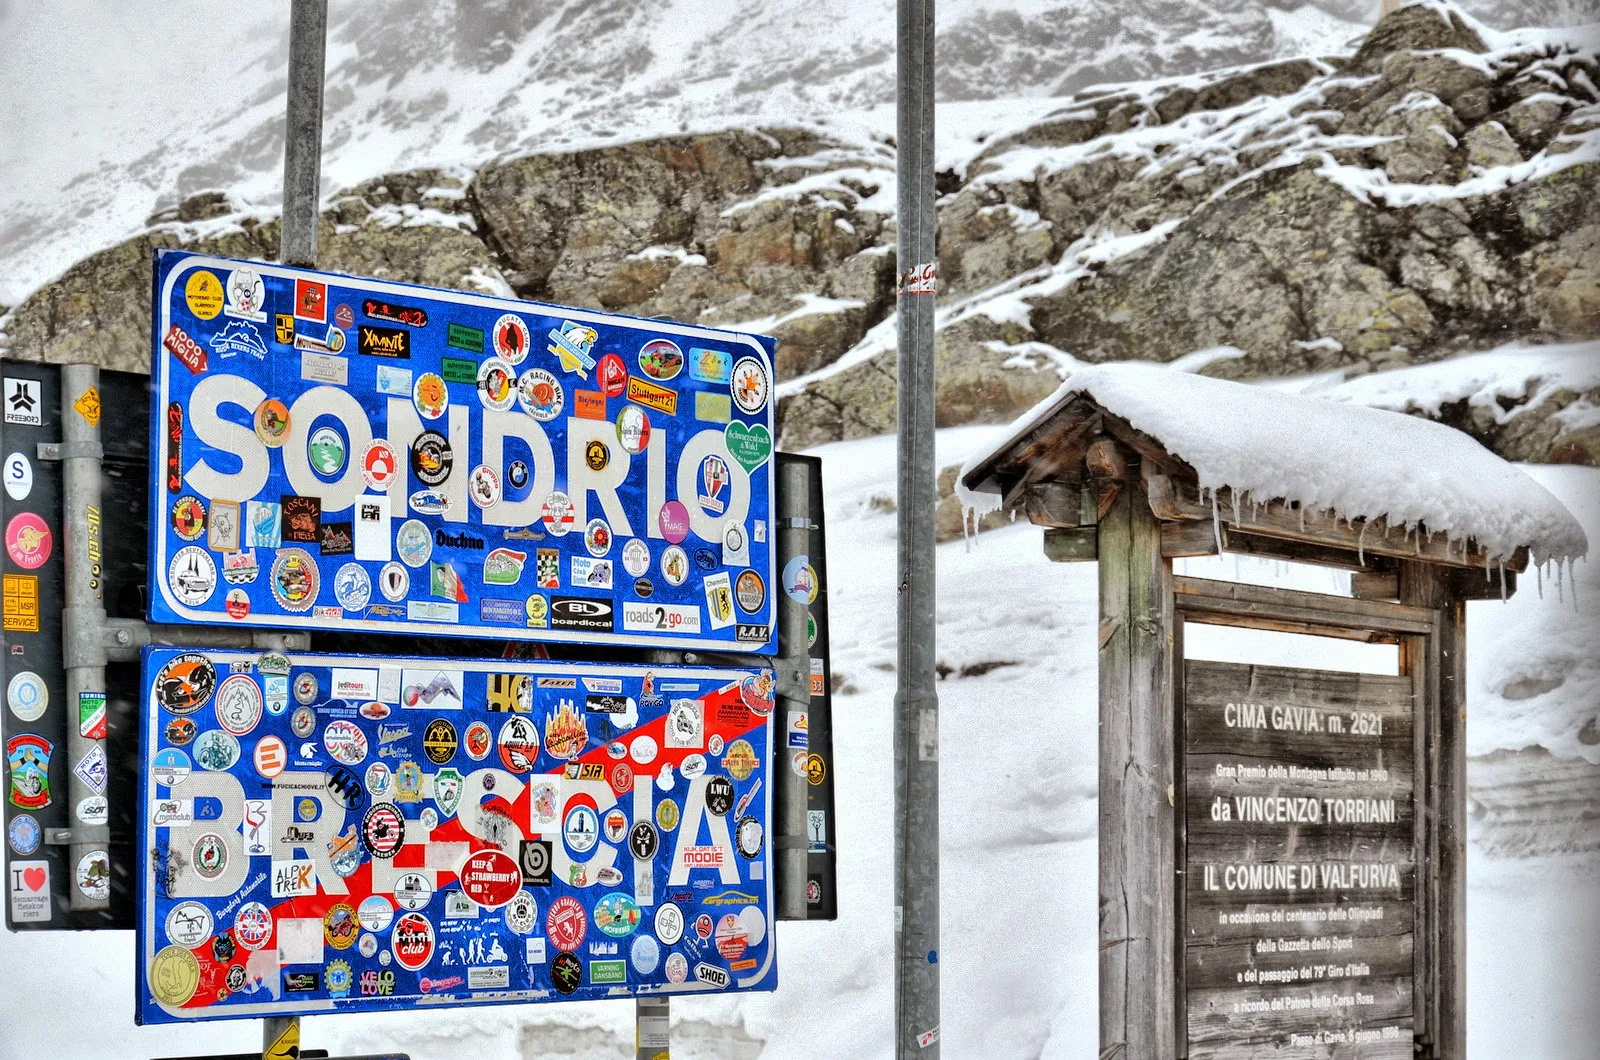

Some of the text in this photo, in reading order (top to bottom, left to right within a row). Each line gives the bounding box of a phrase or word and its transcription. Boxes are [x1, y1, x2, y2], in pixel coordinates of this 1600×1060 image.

[174, 327, 203, 355] 1000
[166, 334, 199, 368] MIGLIA
[530, 372, 555, 387] RACING
[631, 384, 674, 407] Stuttgart 21
[7, 413, 39, 423] FREEBORD
[183, 373, 751, 544] SONDRIO
[12, 461, 24, 479] S
[482, 467, 499, 489] Gruppo
[284, 499, 319, 517] TOSCANI
[294, 532, 316, 540] PIEGA
[573, 558, 591, 567] Moto
[706, 577, 728, 587] Chemnitz
[569, 604, 594, 614] BL
[4, 618, 35, 627] SERVICE
[552, 618, 612, 628] boardlocal
[739, 627, 768, 638] R.A.V.
[184, 655, 214, 674] together
[812, 681, 822, 691] 33
[1224, 703, 1383, 736] CIMA GAVIA: m. 2621
[583, 765, 603, 777] SIR
[1216, 764, 1235, 777] Gran
[1238, 764, 1266, 778] Premio
[1268, 765, 1287, 778] della
[1290, 766, 1327, 781] Montagna
[1357, 770, 1369, 780] nel
[711, 784, 729, 796] LWU
[1211, 797, 1395, 823] da VINCENZO TORRIANI
[168, 770, 741, 898] BRESCIA
[373, 849, 396, 857] BREMEN
[684, 853, 723, 862] MOOIE
[472, 860, 485, 869] KEEP
[277, 865, 299, 880] ALP
[471, 872, 510, 882] STRAWBERRY
[1204, 864, 1399, 891] IL COMUNE DI VALFURVA
[13, 870, 23, 891] I
[471, 884, 482, 893] RED
[514, 898, 530, 906] ASKER
[1219, 907, 1384, 923] in occasione del centenario delle Olimpiadi
[399, 936, 428, 947] MINI
[401, 942, 425, 954] club
[1256, 936, 1353, 953] della Gazzetta dello Sport
[566, 958, 580, 972] moto
[361, 971, 394, 981] VELO
[700, 967, 726, 985] SHOEI
[1237, 974, 1243, 982] e
[1244, 969, 1257, 982] del
[1259, 969, 1298, 984] passaggio
[1300, 967, 1312, 980] del
[1328, 964, 1344, 977] Giro
[1345, 963, 1370, 976] d'Italia
[361, 984, 393, 995] LOVE
[1240, 1000, 1270, 1013] ricordo
[1271, 998, 1284, 1011] del
[1285, 996, 1311, 1010] Patron
[1332, 994, 1354, 1008] Corsa
[1356, 993, 1374, 1006] Rosa
[1291, 1034, 1313, 1047] Passo
[1355, 1030, 1381, 1044] giugno
